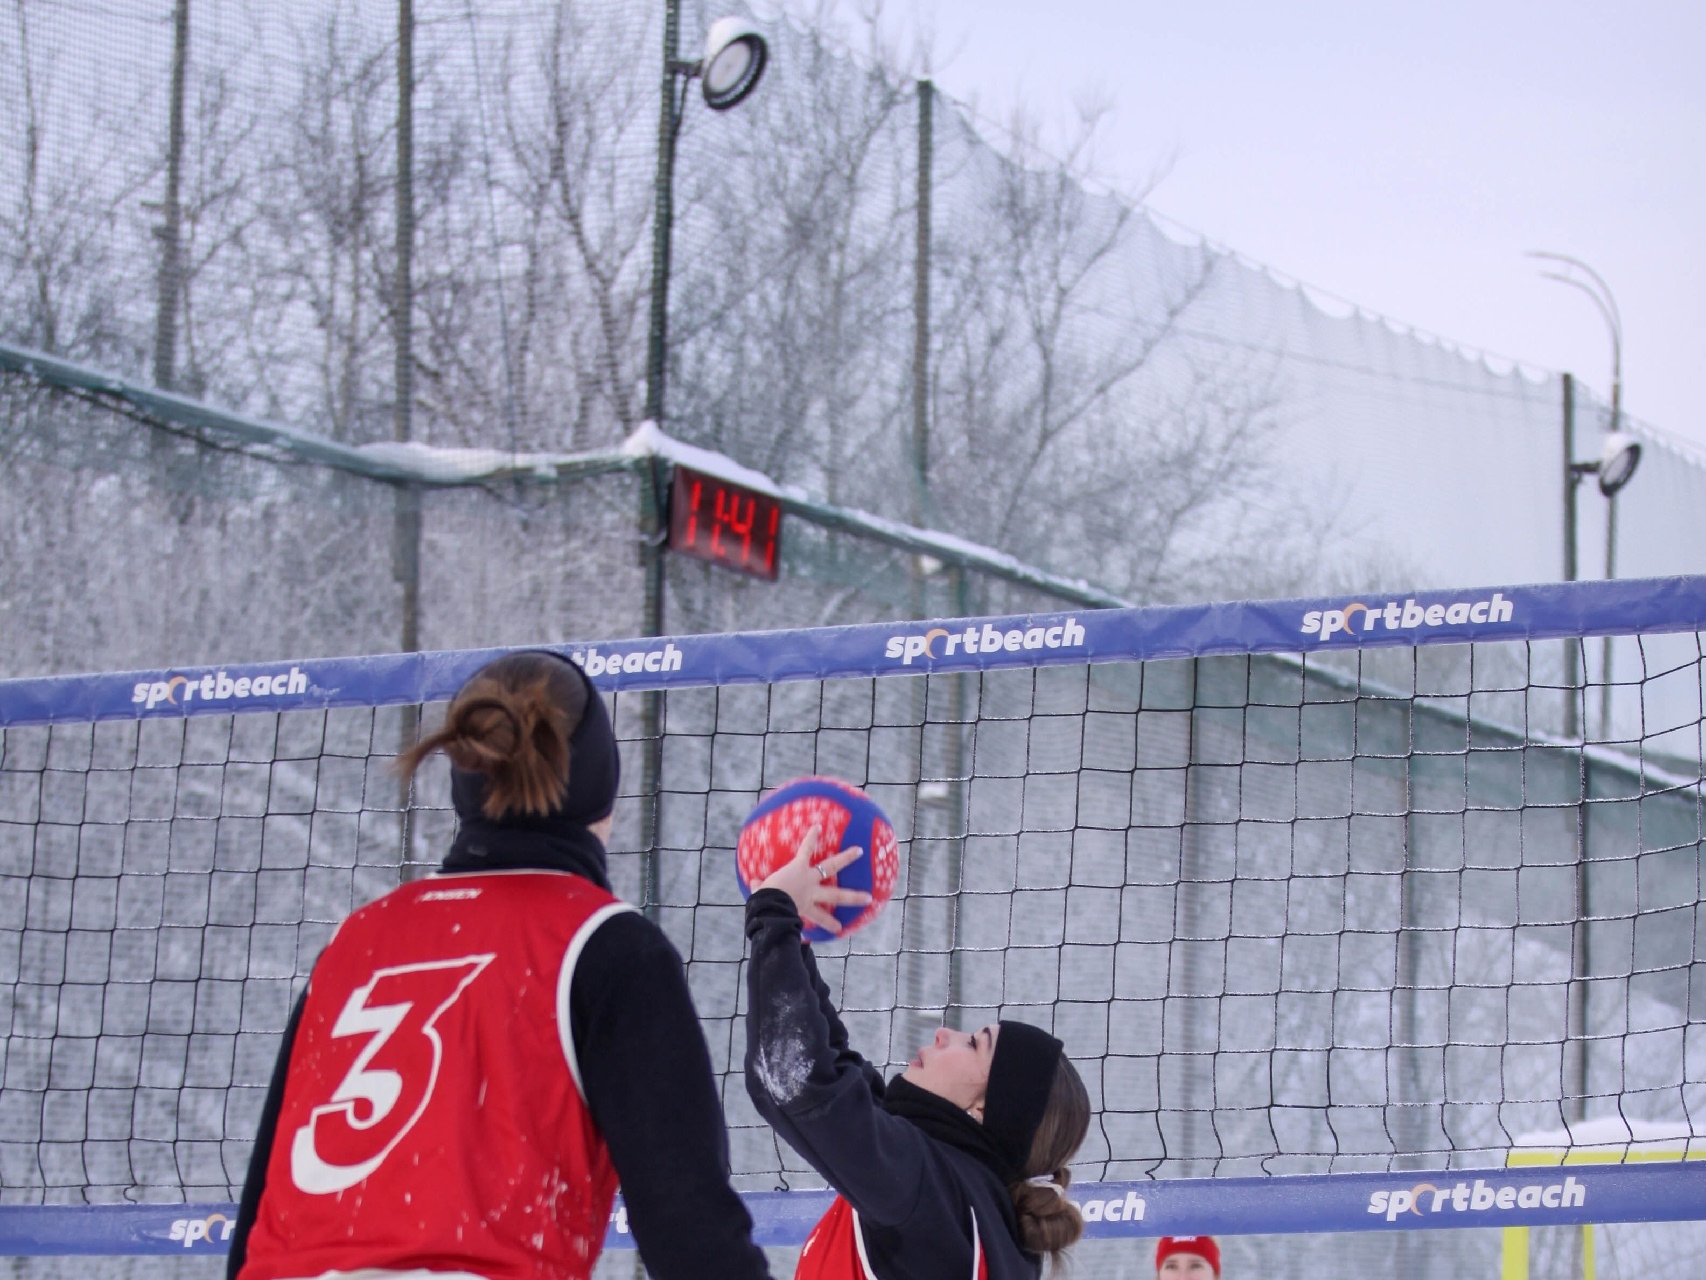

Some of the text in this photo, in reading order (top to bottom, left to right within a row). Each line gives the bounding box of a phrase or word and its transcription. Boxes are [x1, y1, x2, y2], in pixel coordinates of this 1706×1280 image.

[1301, 593, 1514, 641] sportbeach
[572, 643, 683, 677] tbeach
[885, 618, 1086, 665] sportbeach
[127, 666, 307, 709] sportbeach
[290, 952, 498, 1195] 3
[1367, 1176, 1586, 1222] sportbeach
